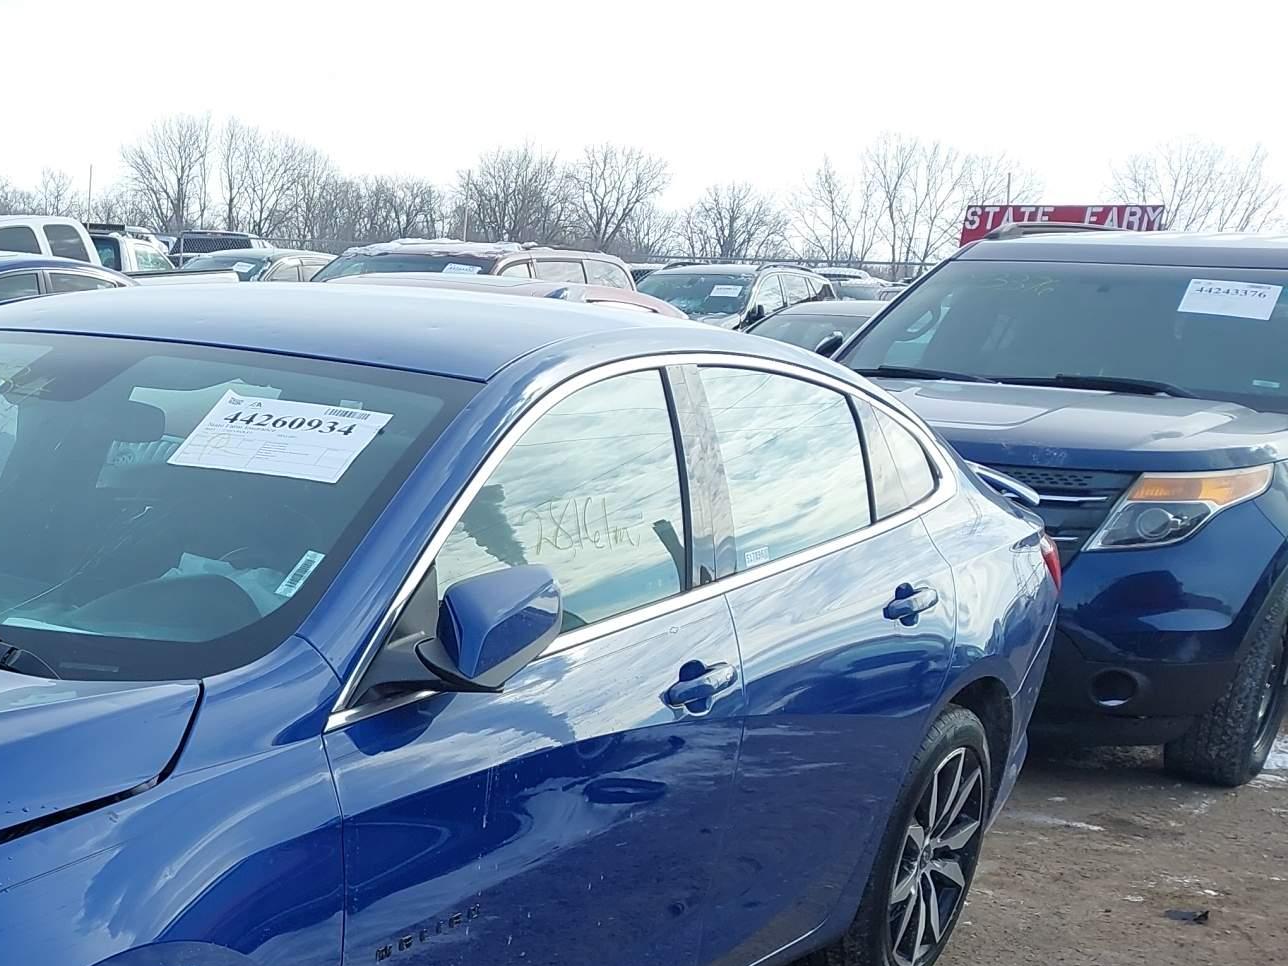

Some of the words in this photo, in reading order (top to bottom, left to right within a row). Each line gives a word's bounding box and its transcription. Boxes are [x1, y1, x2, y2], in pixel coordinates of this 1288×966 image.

[965, 206, 1055, 230] STATE
[1084, 206, 1164, 231] FARM
[1195, 286, 1267, 299] 44243376
[223, 411, 359, 436] 44260934
